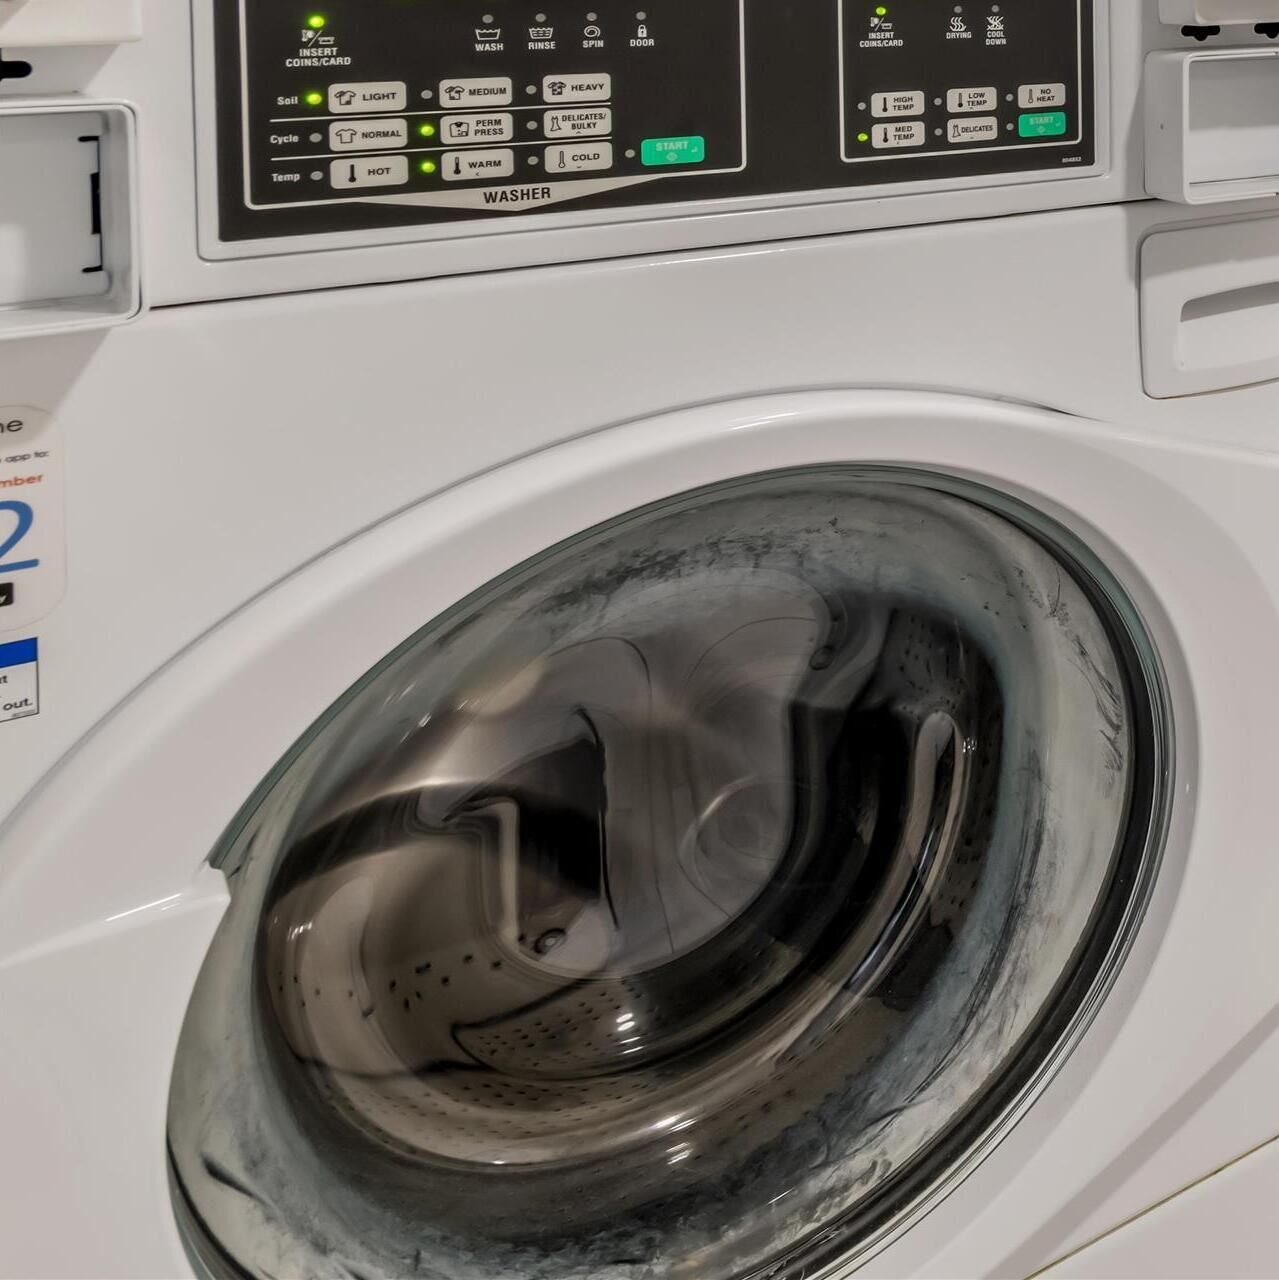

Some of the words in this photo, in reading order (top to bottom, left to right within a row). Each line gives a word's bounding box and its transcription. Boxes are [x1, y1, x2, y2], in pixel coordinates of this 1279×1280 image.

[868, 31, 894, 39] INSERT
[946, 31, 972, 39] DRYING
[986, 30, 1005, 38] COOL
[528, 41, 556, 50] RINSE
[582, 39, 604, 48] SPIN
[629, 38, 655, 47] DOOR
[859, 39, 904, 48] COINS/CARD
[985, 38, 1007, 46] DOWN
[474, 42, 504, 52] WASH
[299, 47, 339, 57] INSERT
[285, 56, 352, 68] COINS/CARD
[468, 87, 507, 96] MEDIUM
[571, 83, 605, 92] HEAVY
[277, 96, 299, 106] Soil
[362, 92, 397, 102] LIGHT
[893, 96, 914, 104] HIGH
[1036, 95, 1056, 103] HEAT
[892, 103, 915, 111] TEMP
[966, 99, 988, 107] TEMP
[561, 113, 606, 122] DELICATES/
[475, 118, 502, 127] PERM
[571, 121, 598, 130] BULKY
[474, 127, 504, 136] PRESS
[894, 125, 913, 133] MED
[961, 125, 994, 134] DELICATES
[269, 133, 300, 144] Cycle
[361, 129, 402, 139] NORMAL
[892, 132, 915, 141] TEMP
[655, 141, 689, 152] START
[571, 152, 600, 162] COLD
[468, 159, 502, 169] WARM
[367, 167, 391, 176] HOT
[271, 173, 300, 183] Temp
[483, 187, 551, 204] WASHER
[5, 453, 32, 464] app
[0, 474, 43, 488] mber
[0, 500, 40, 573] 2
[3, 698, 34, 711] out.
